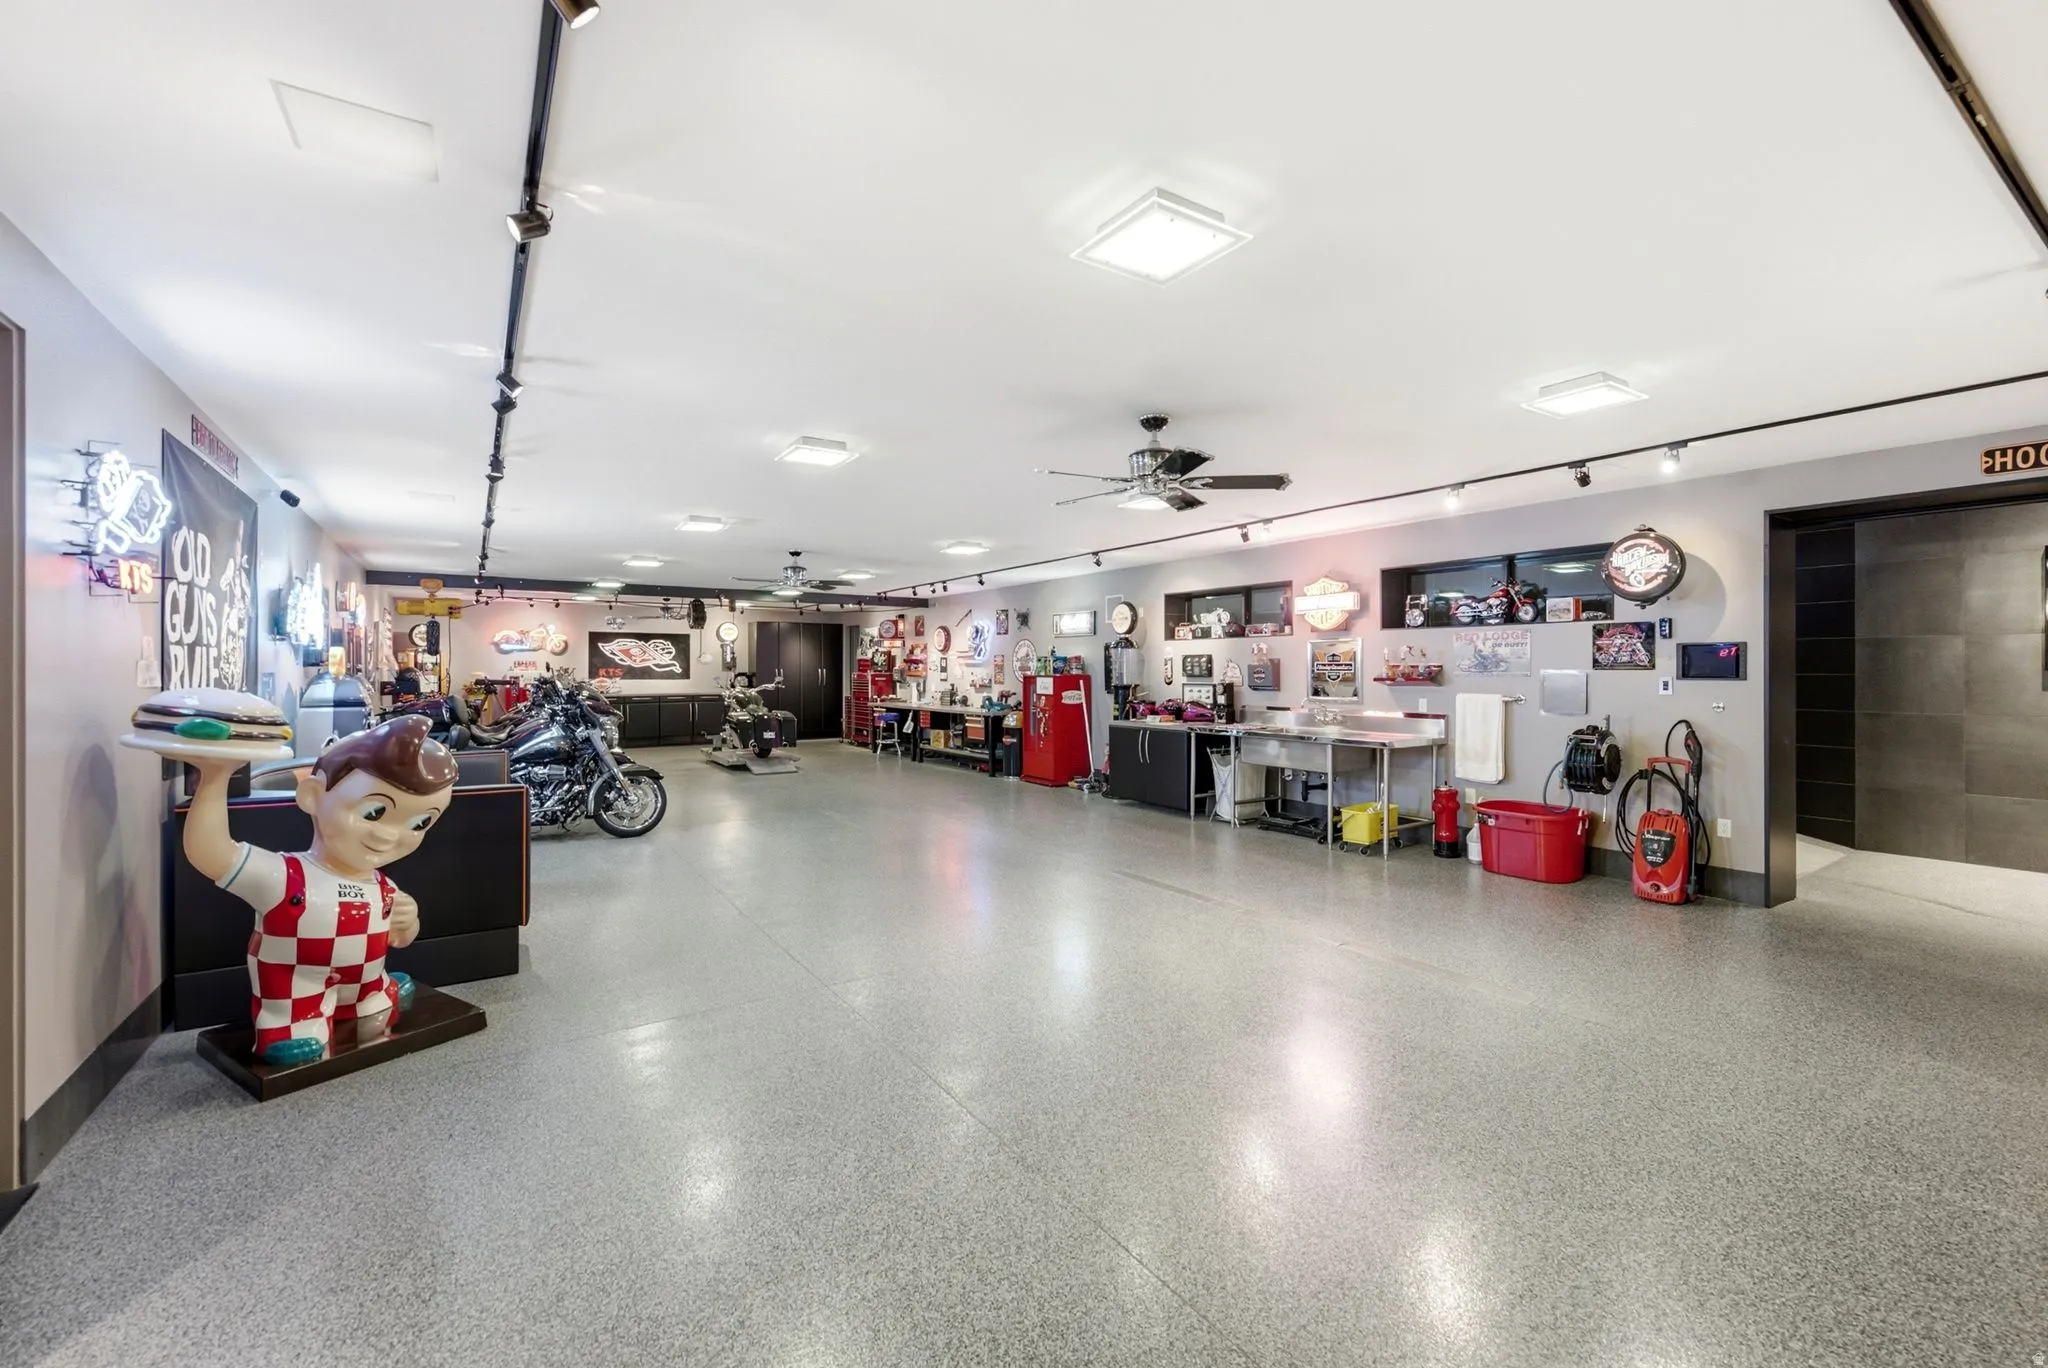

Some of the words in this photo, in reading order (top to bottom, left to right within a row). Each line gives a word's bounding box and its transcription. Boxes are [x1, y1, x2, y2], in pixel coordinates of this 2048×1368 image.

[172, 525, 211, 588] OLD
[117, 558, 154, 594] KTS
[1455, 632, 1480, 643] RED
[338, 883, 363, 891] BIG
[338, 890, 365, 899] BOY
